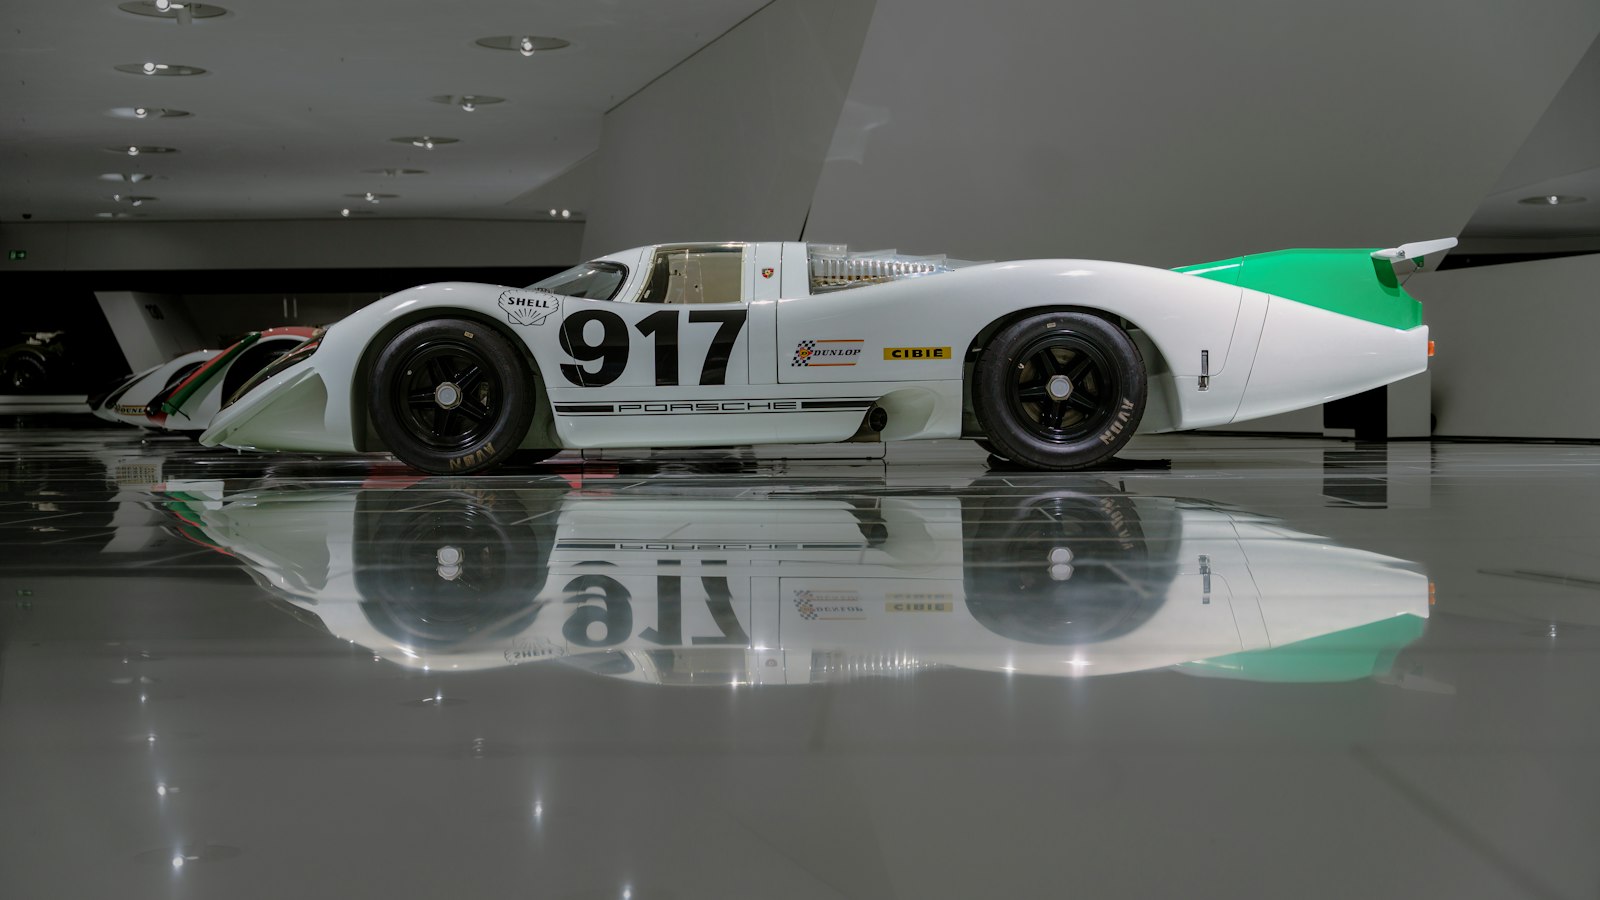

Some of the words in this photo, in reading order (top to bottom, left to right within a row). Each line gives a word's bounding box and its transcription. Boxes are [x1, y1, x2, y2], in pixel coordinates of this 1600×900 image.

[508, 297, 549, 308] SHELL
[559, 309, 747, 387] 917
[619, 402, 796, 412] PORSCHE
[1100, 398, 1134, 445] AVON
